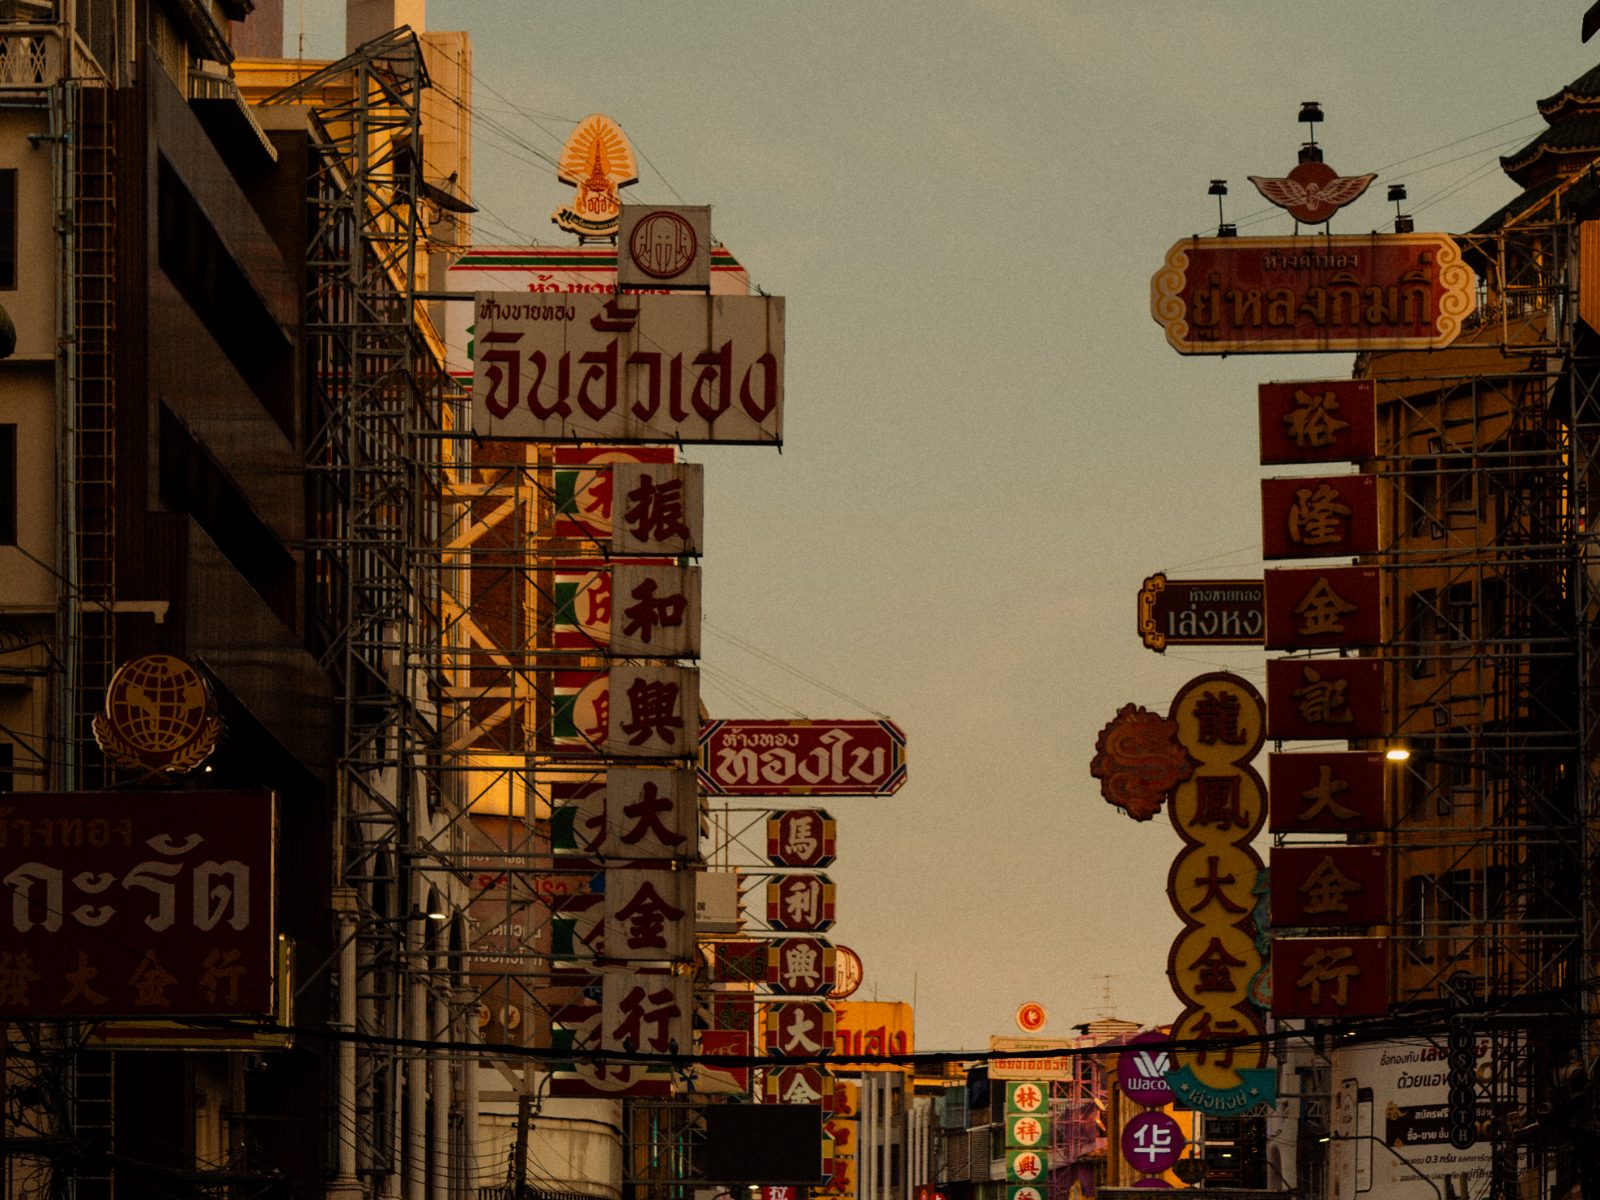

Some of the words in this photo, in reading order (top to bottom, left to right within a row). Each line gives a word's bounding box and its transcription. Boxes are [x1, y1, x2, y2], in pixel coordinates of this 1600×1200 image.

[480, 299, 576, 321] ห้างขายทอง
[715, 728, 887, 785] ทองใบ
[722, 728, 799, 748] ห้างทอง
[3, 833, 251, 934] กะรัต
[1133, 1123, 1172, 1163] 华
